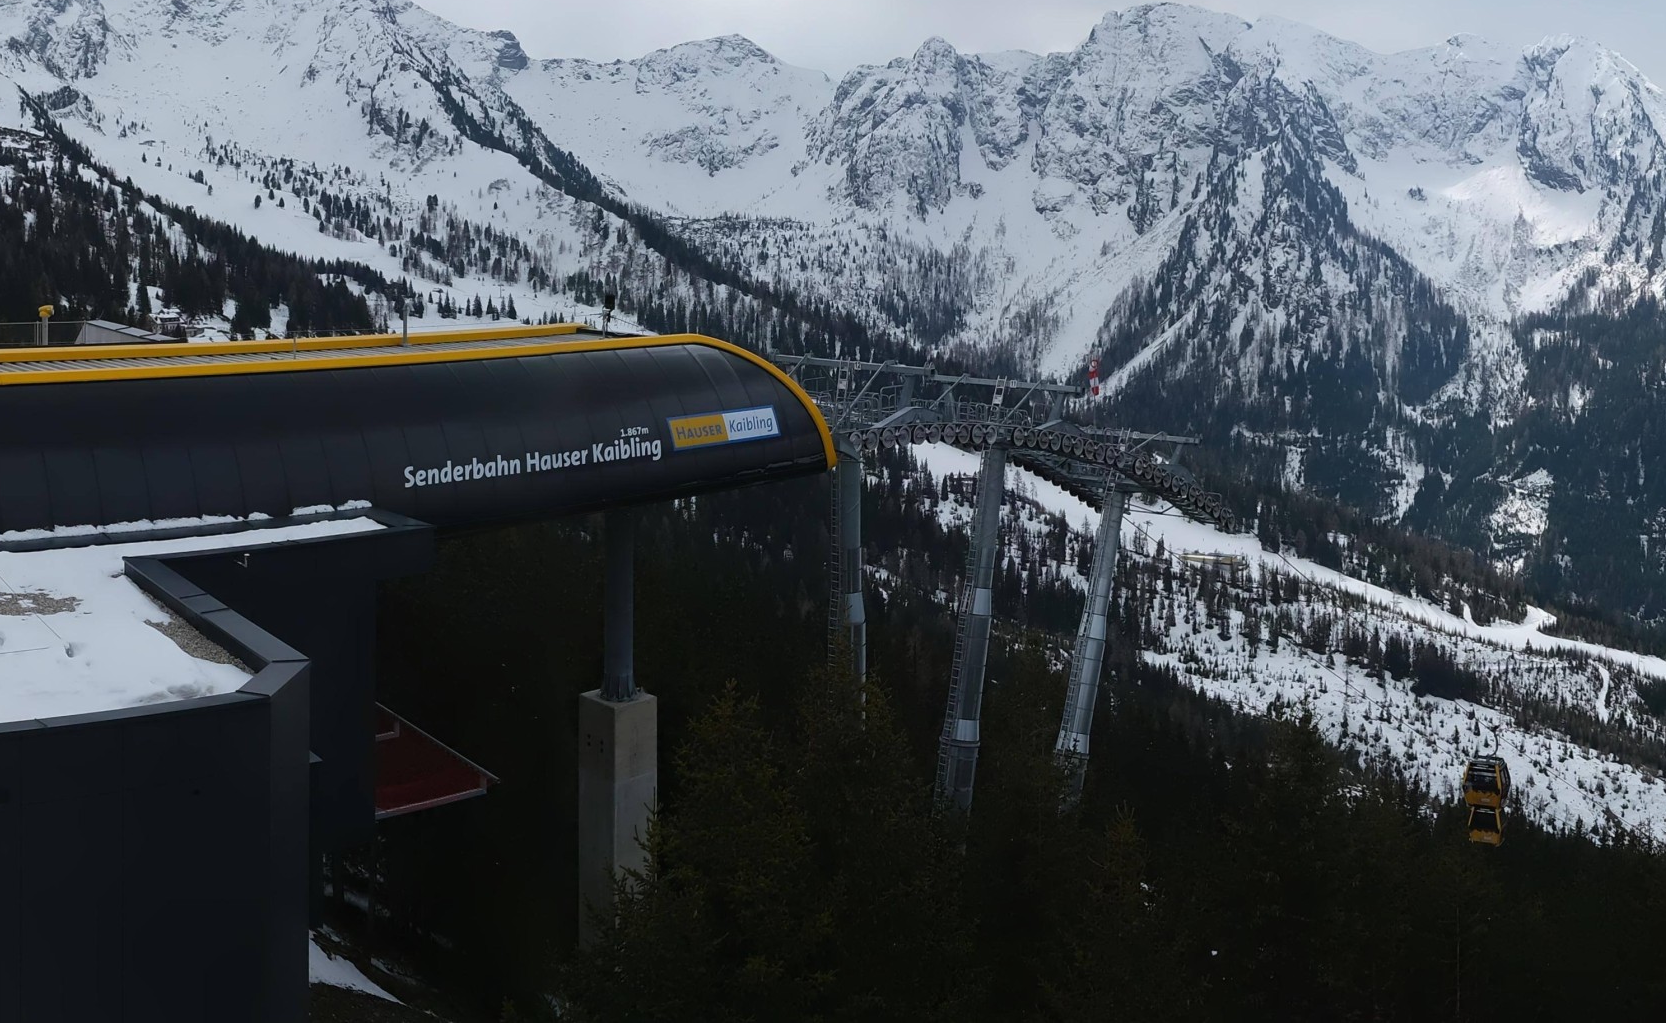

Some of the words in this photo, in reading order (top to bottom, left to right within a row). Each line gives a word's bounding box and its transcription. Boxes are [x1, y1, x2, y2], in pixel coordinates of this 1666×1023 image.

[620, 426, 649, 438] 1.867m
[676, 424, 723, 440] HAUSER
[728, 416, 773, 433] Kaibling
[404, 455, 521, 488] Senderbahn
[526, 449, 588, 472] Hauser
[592, 437, 662, 463] Kaibling
